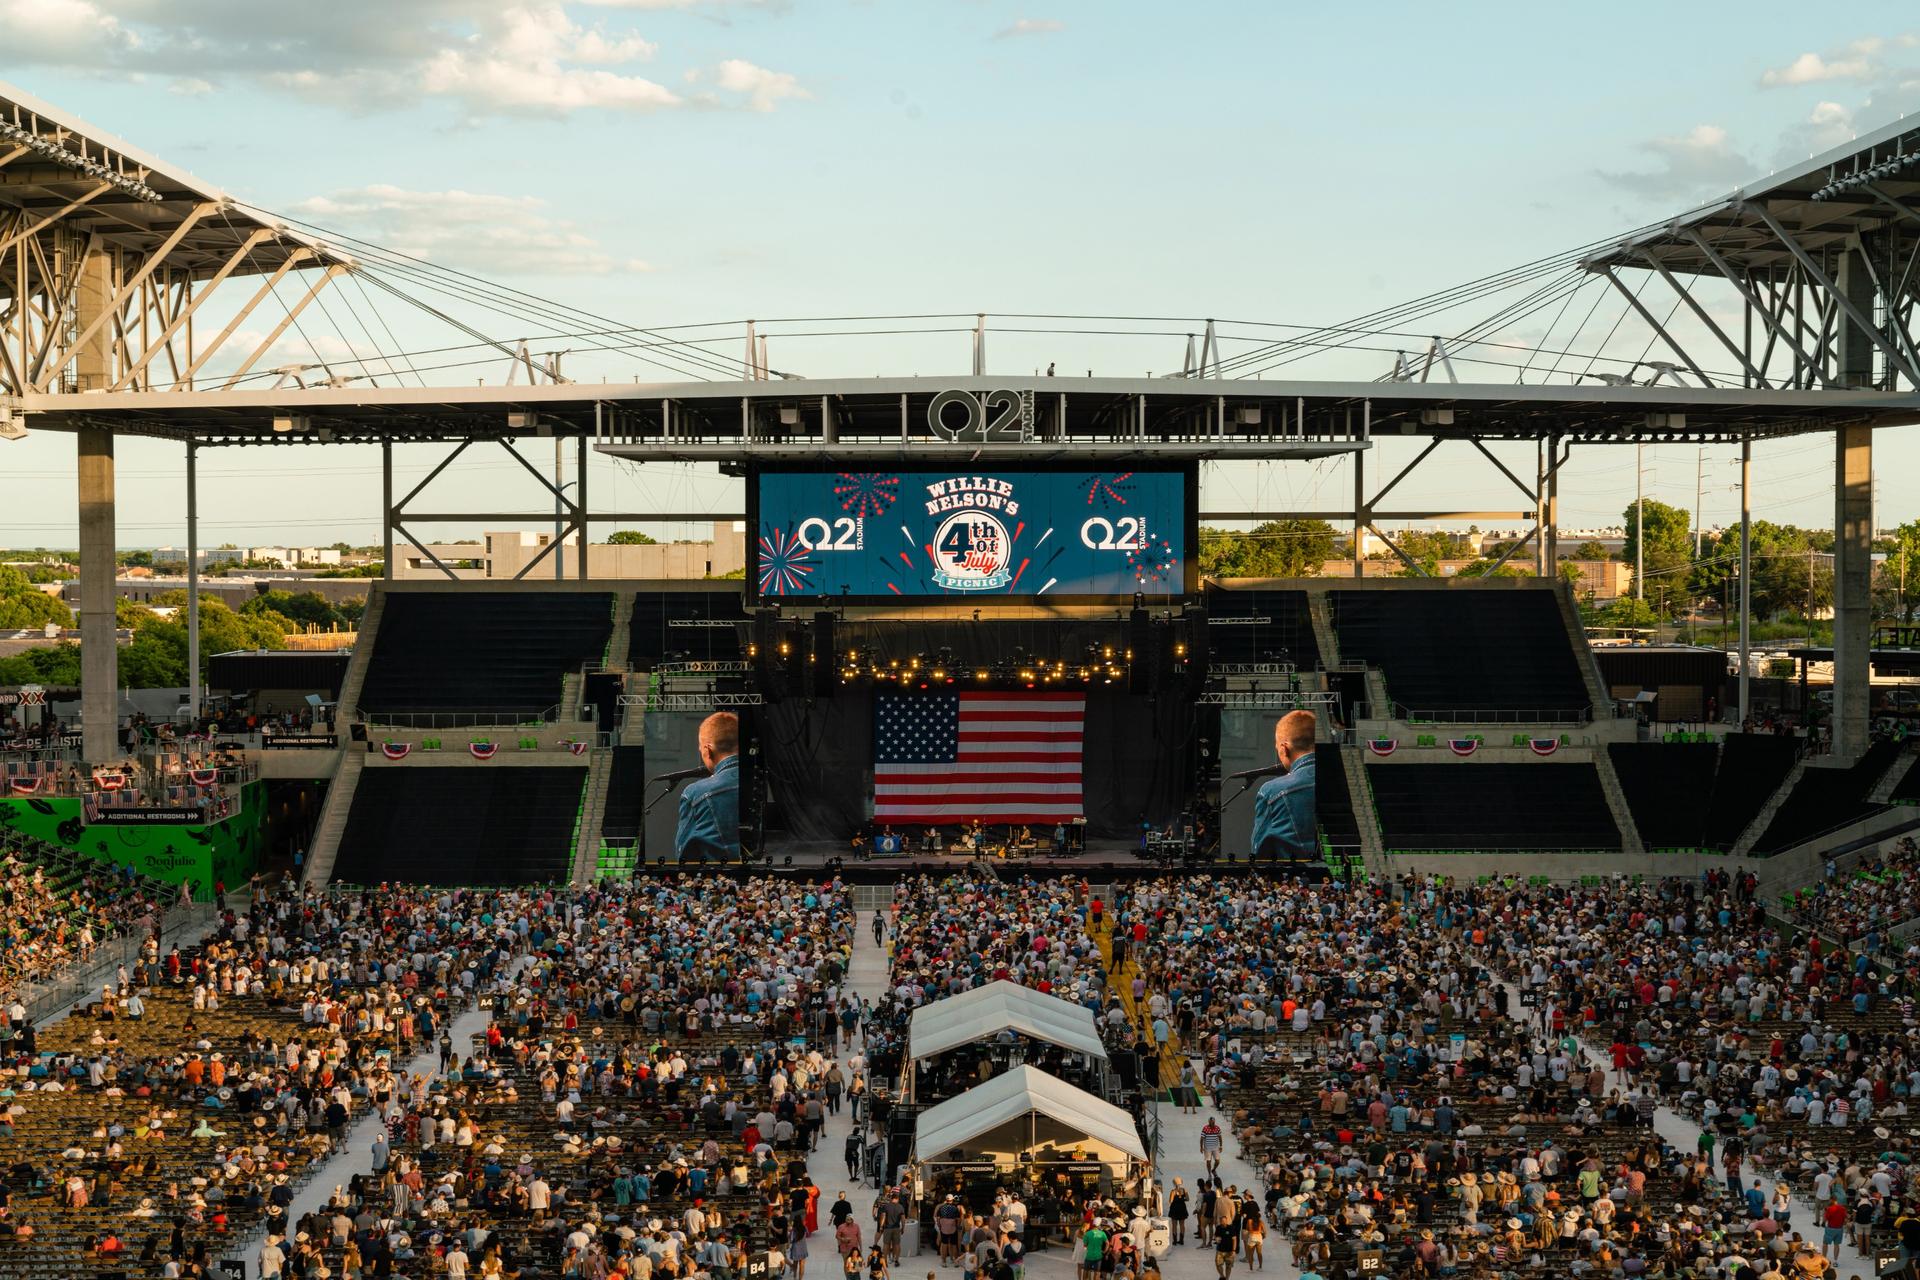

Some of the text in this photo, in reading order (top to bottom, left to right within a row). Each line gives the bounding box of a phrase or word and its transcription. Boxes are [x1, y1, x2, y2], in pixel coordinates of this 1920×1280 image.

[928, 389, 1034, 443] Q2 STADIUM
[926, 477, 1013, 498] WILLIE
[925, 493, 1019, 516] NELSON'S
[798, 517, 864, 550] Q2 STADIUM
[1081, 516, 1138, 550] Q2
[961, 551, 998, 574] July
[946, 577, 998, 588] PICNIC
[19, 690, 46, 706] XX
[480, 998, 493, 1007] A4
[811, 997, 823, 1005] A4
[1193, 994, 1202, 1003] A2
[1522, 994, 1535, 1002] A2
[1617, 1000, 1629, 1009] A1
[391, 1006, 404, 1015] A5
[750, 1261, 766, 1275] B4
[1362, 1258, 1379, 1270] B2
